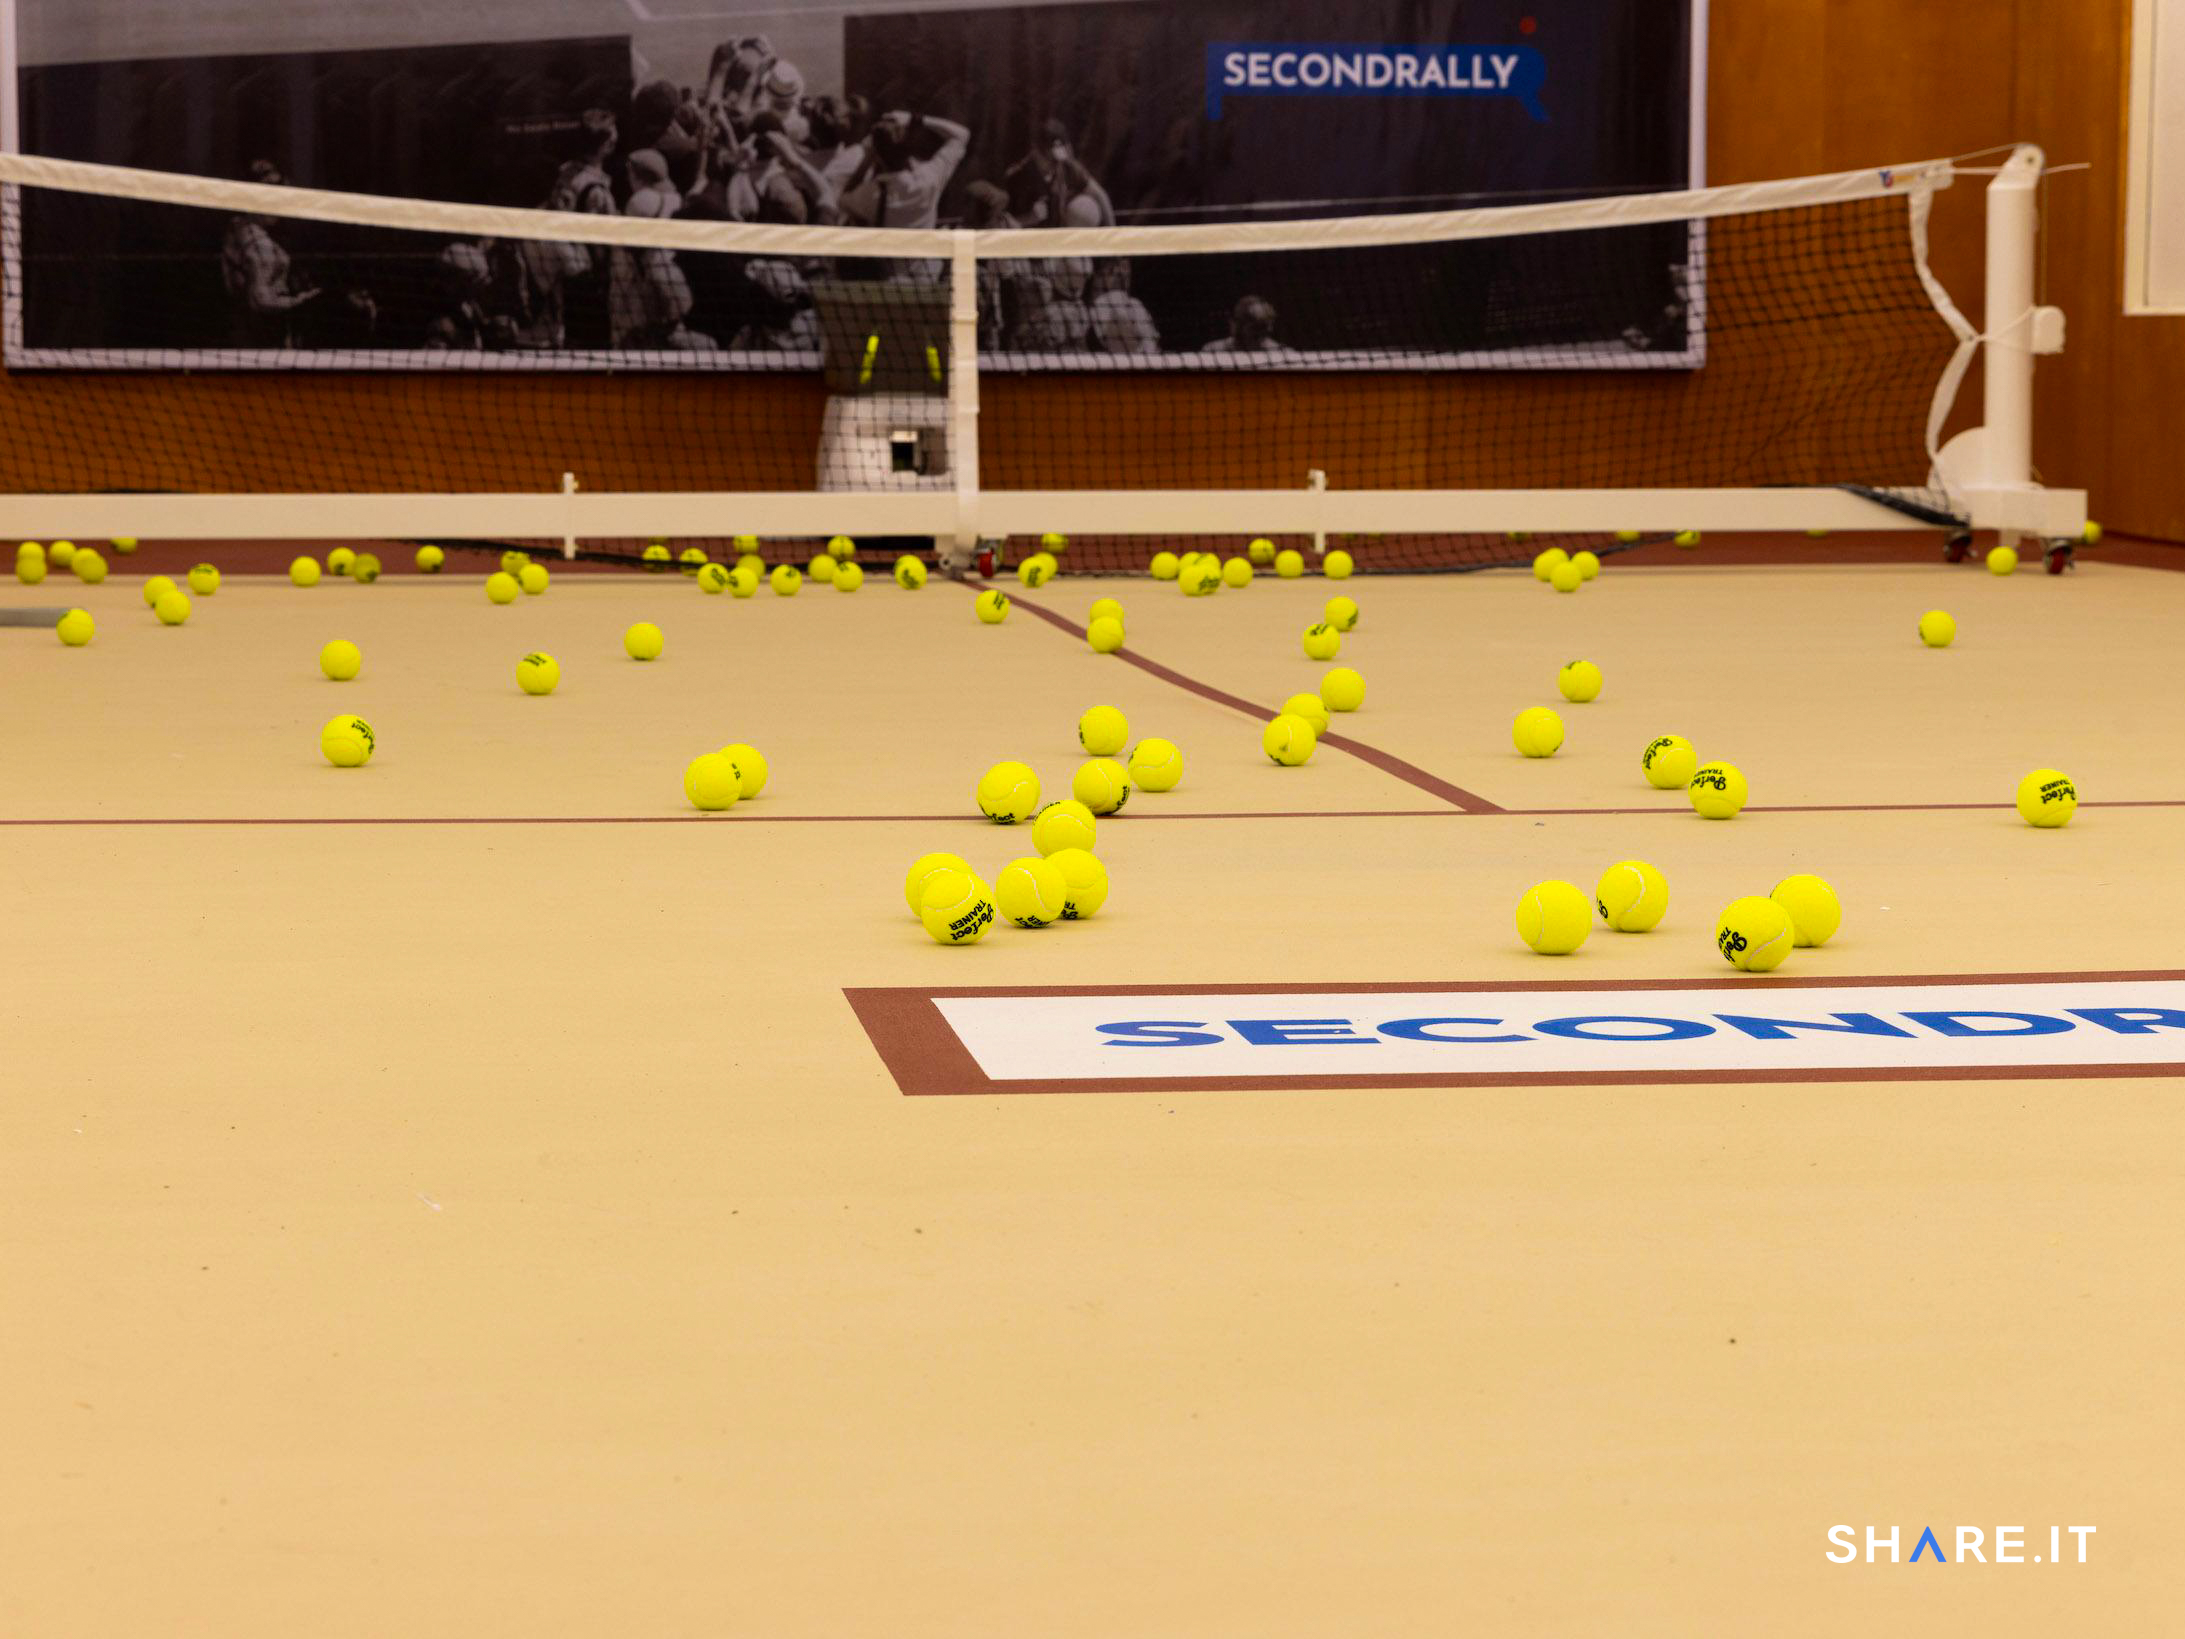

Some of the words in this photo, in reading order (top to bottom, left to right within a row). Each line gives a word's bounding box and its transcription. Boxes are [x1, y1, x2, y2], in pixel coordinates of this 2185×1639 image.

[1223, 52, 1518, 88] SECONDRALLY
[948, 899, 987, 931] TRAINER
[949, 903, 995, 941] Perfect
